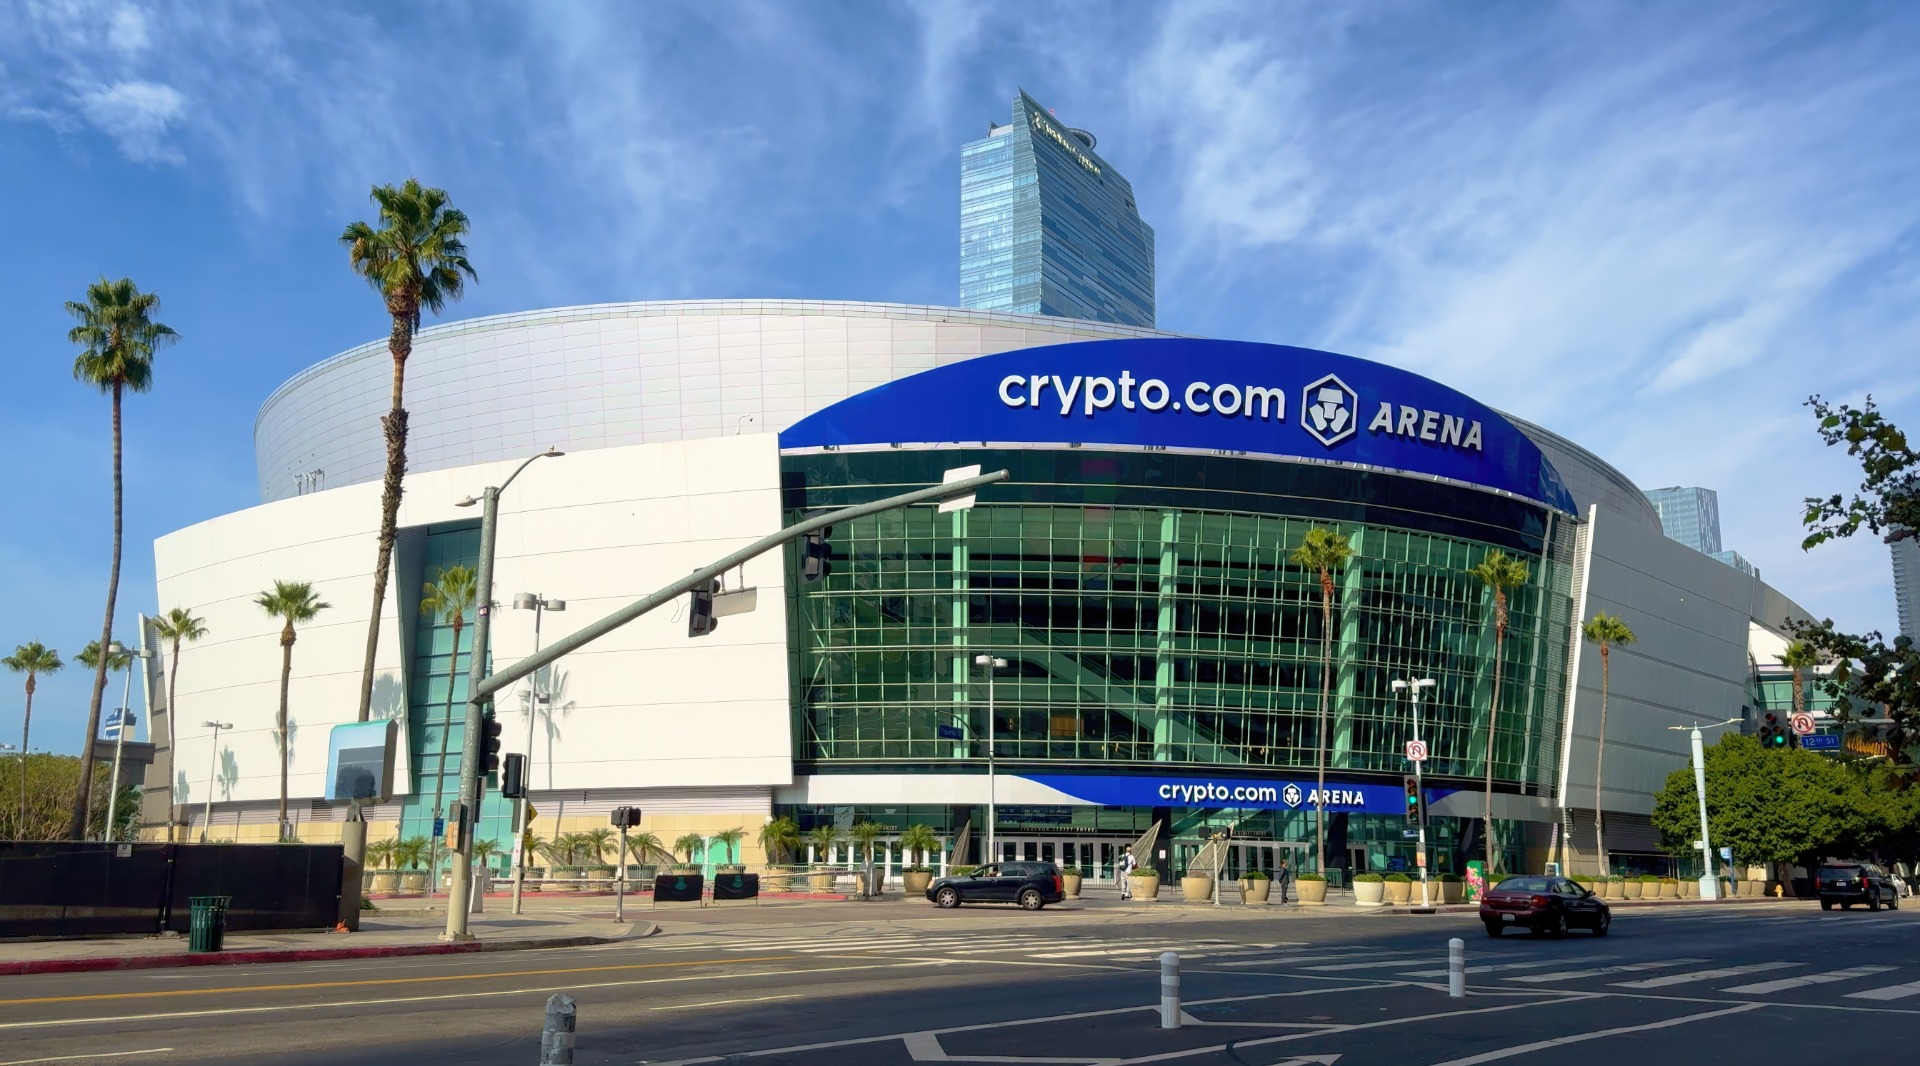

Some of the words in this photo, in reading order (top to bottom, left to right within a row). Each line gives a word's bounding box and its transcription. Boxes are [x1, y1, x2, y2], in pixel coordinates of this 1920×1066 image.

[998, 370, 1286, 420] crypto.com
[1368, 402, 1483, 452] ARENA
[1805, 737, 1823, 746] 12th
[1826, 737, 1835, 745] St
[1159, 782, 1277, 803] crypto.com
[1307, 788, 1365, 805] ARENA
